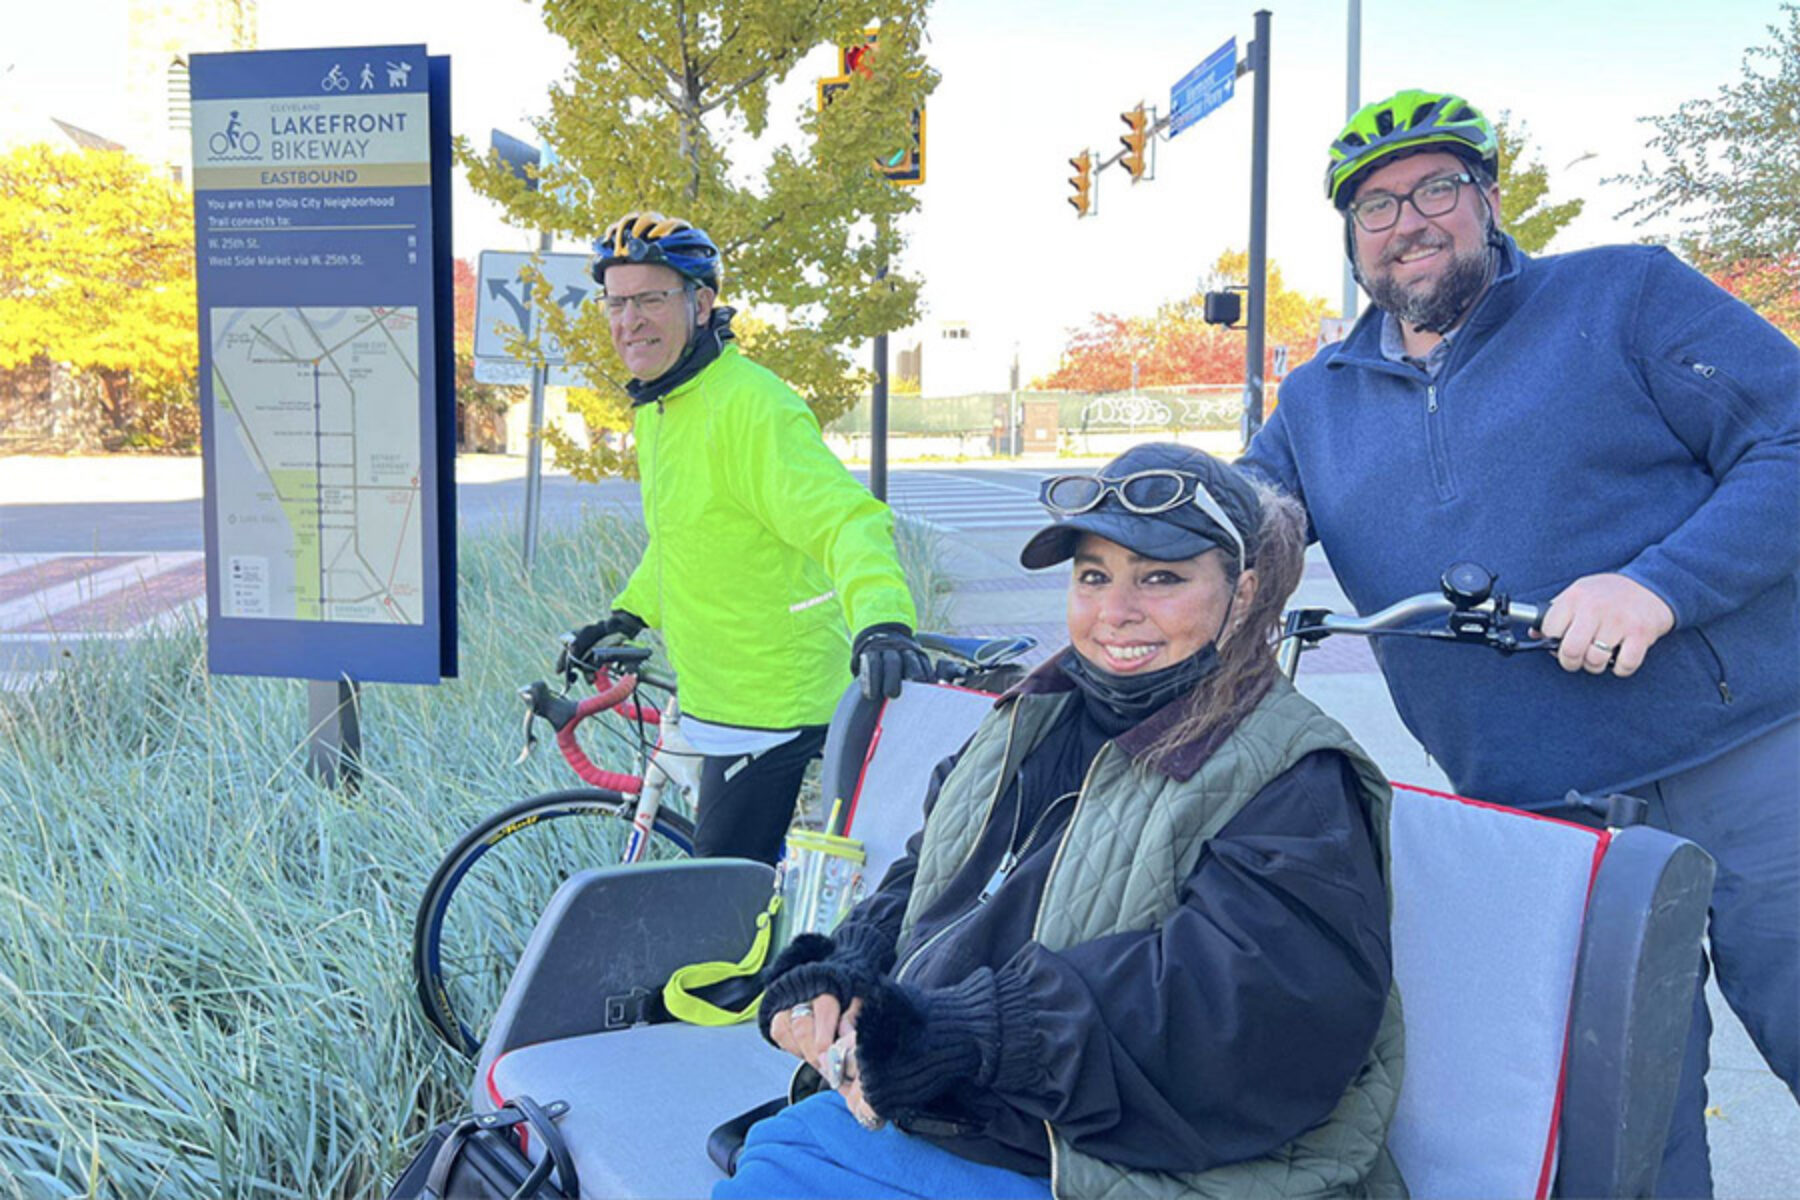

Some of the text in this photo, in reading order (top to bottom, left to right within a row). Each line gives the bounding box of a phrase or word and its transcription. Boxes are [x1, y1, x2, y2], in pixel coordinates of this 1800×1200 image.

[271, 113, 407, 135] LAKEFRONT
[271, 139, 369, 160] BIKEWAY
[261, 170, 357, 185] EASTBOUND
[208, 199, 225, 209] You
[246, 199, 254, 208] in
[257, 198, 273, 208] the
[276, 197, 298, 208] Ohio
[301, 197, 320, 210] City
[324, 196, 395, 209] Neighborhood
[208, 216, 291, 227] Trail connects to:
[221, 238, 245, 248] 25th
[208, 256, 232, 266] West
[234, 256, 255, 266] Side
[258, 255, 293, 266] Market
[294, 256, 309, 266] via
[325, 255, 348, 265] 25th
